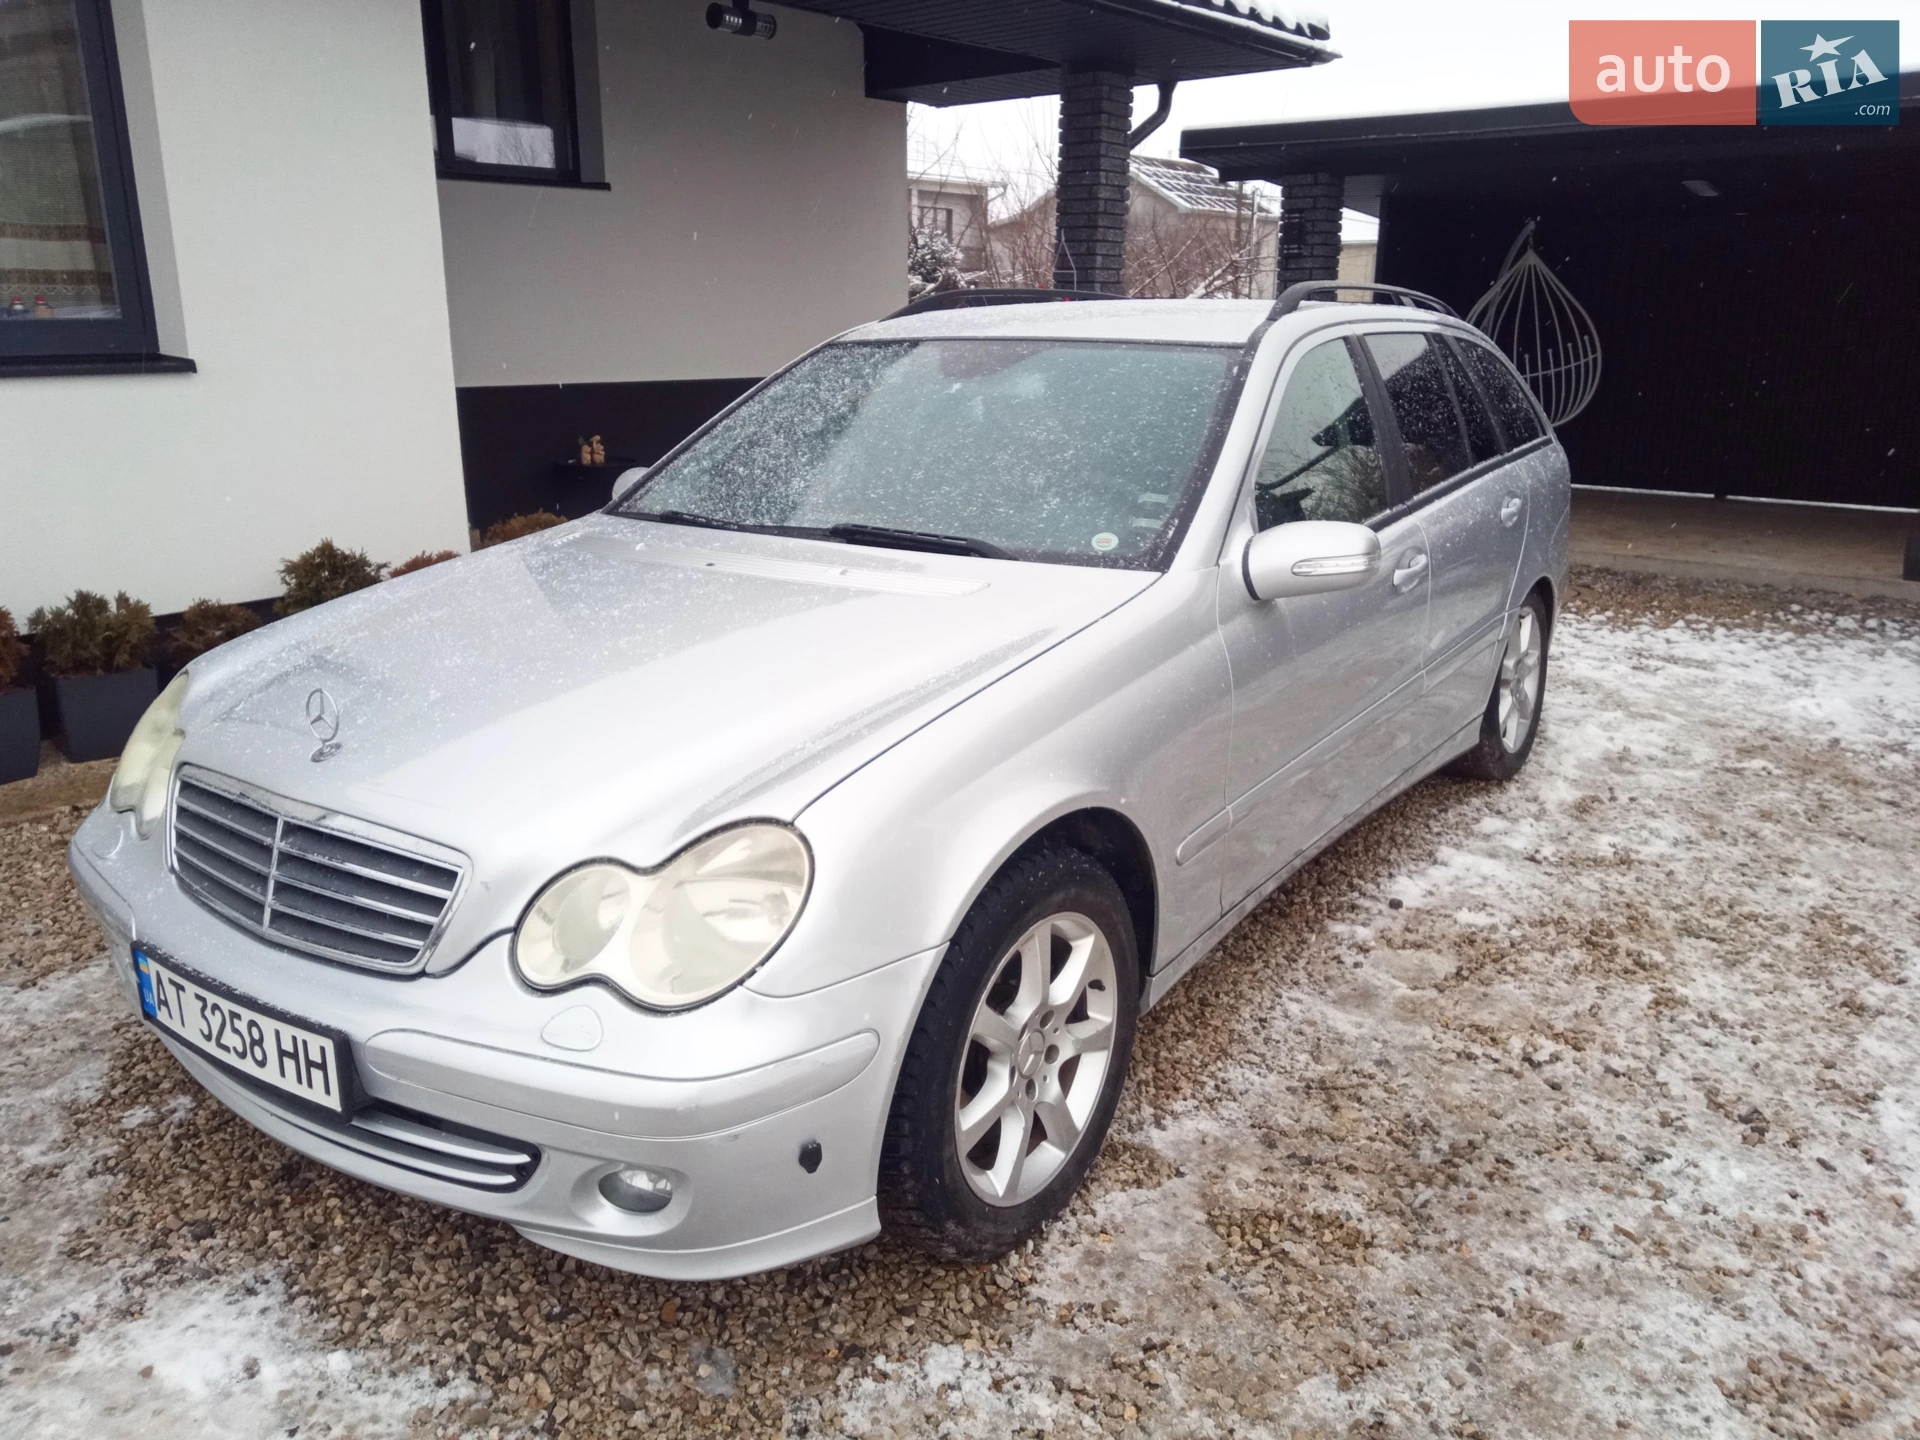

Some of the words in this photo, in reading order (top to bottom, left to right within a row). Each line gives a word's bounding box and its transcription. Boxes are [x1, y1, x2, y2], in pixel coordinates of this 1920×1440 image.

[143, 988, 156, 1007] UA
[155, 969, 186, 1029] AT
[194, 992, 268, 1069] 3258
[274, 1028, 331, 1097] HH
